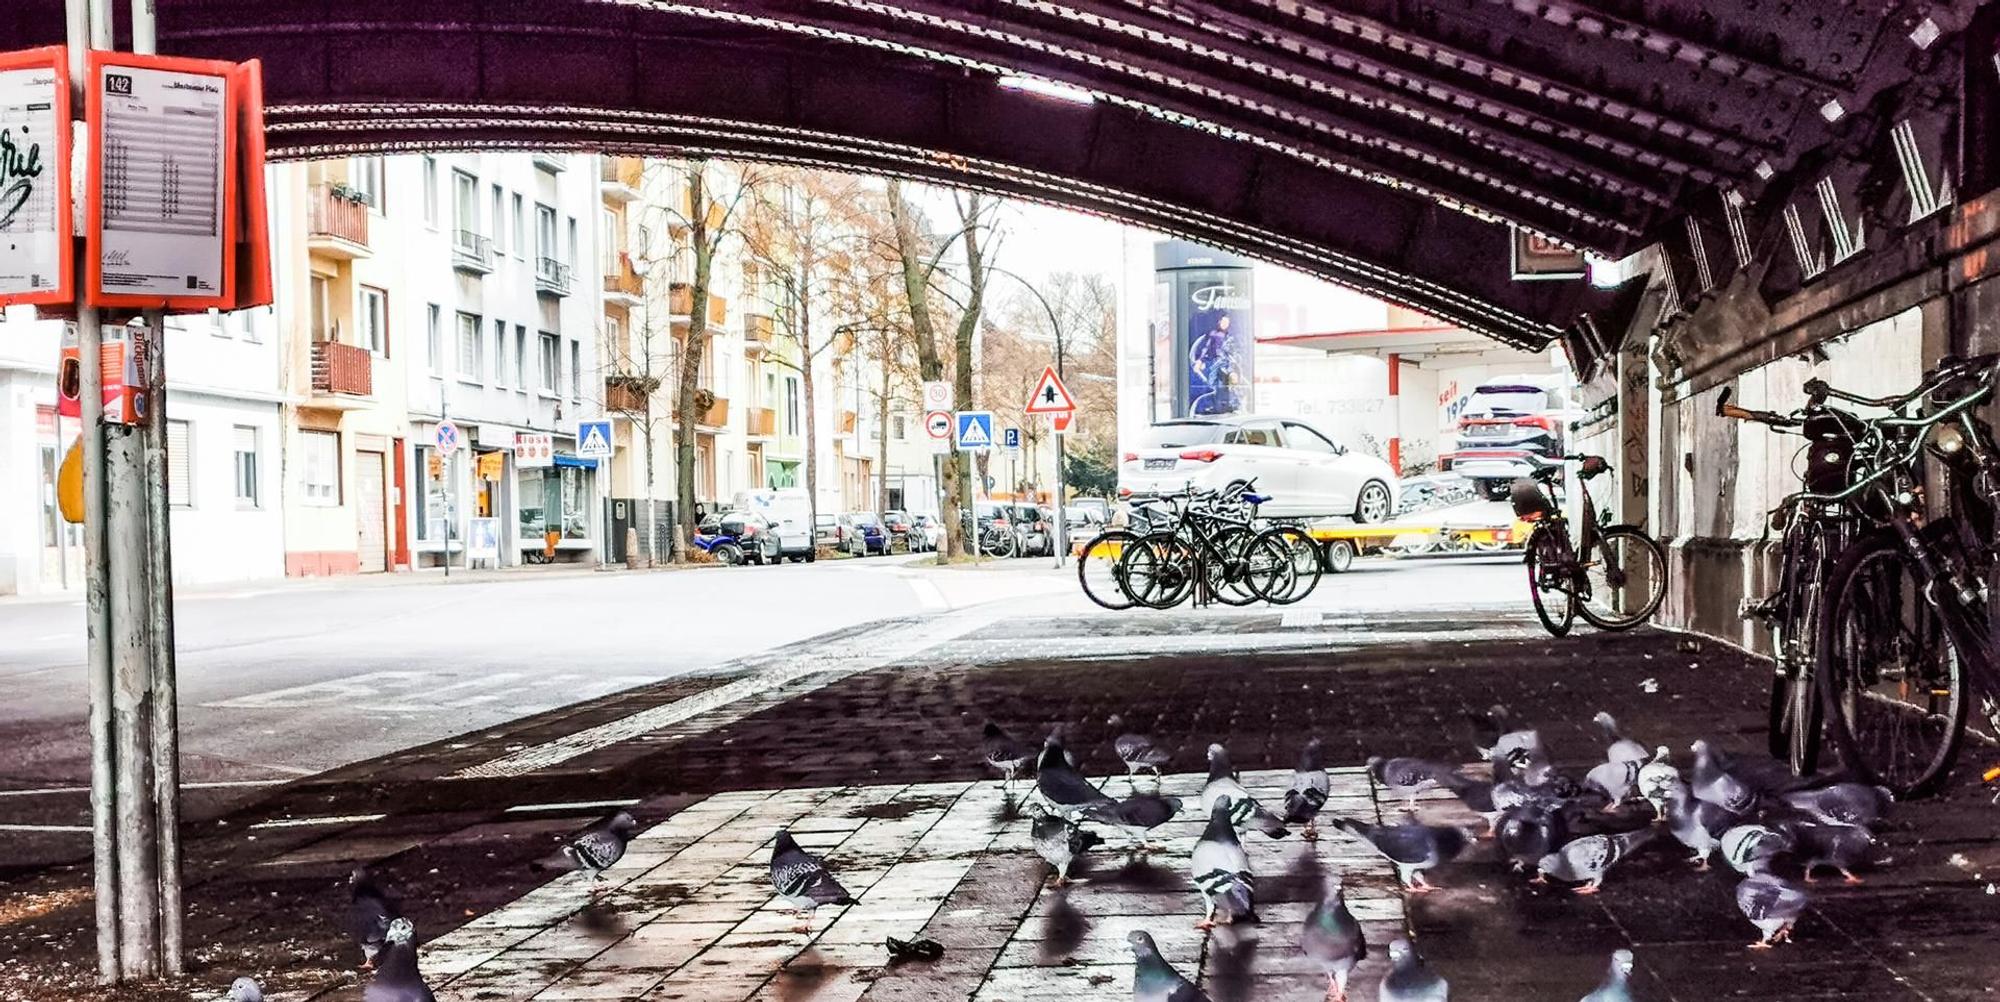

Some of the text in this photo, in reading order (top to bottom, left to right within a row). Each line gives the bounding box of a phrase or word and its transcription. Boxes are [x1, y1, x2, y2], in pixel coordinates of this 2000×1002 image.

[109, 77, 129, 91] 142
[1439, 380, 1457, 406] seit
[516, 433, 549, 445] Kiosk
